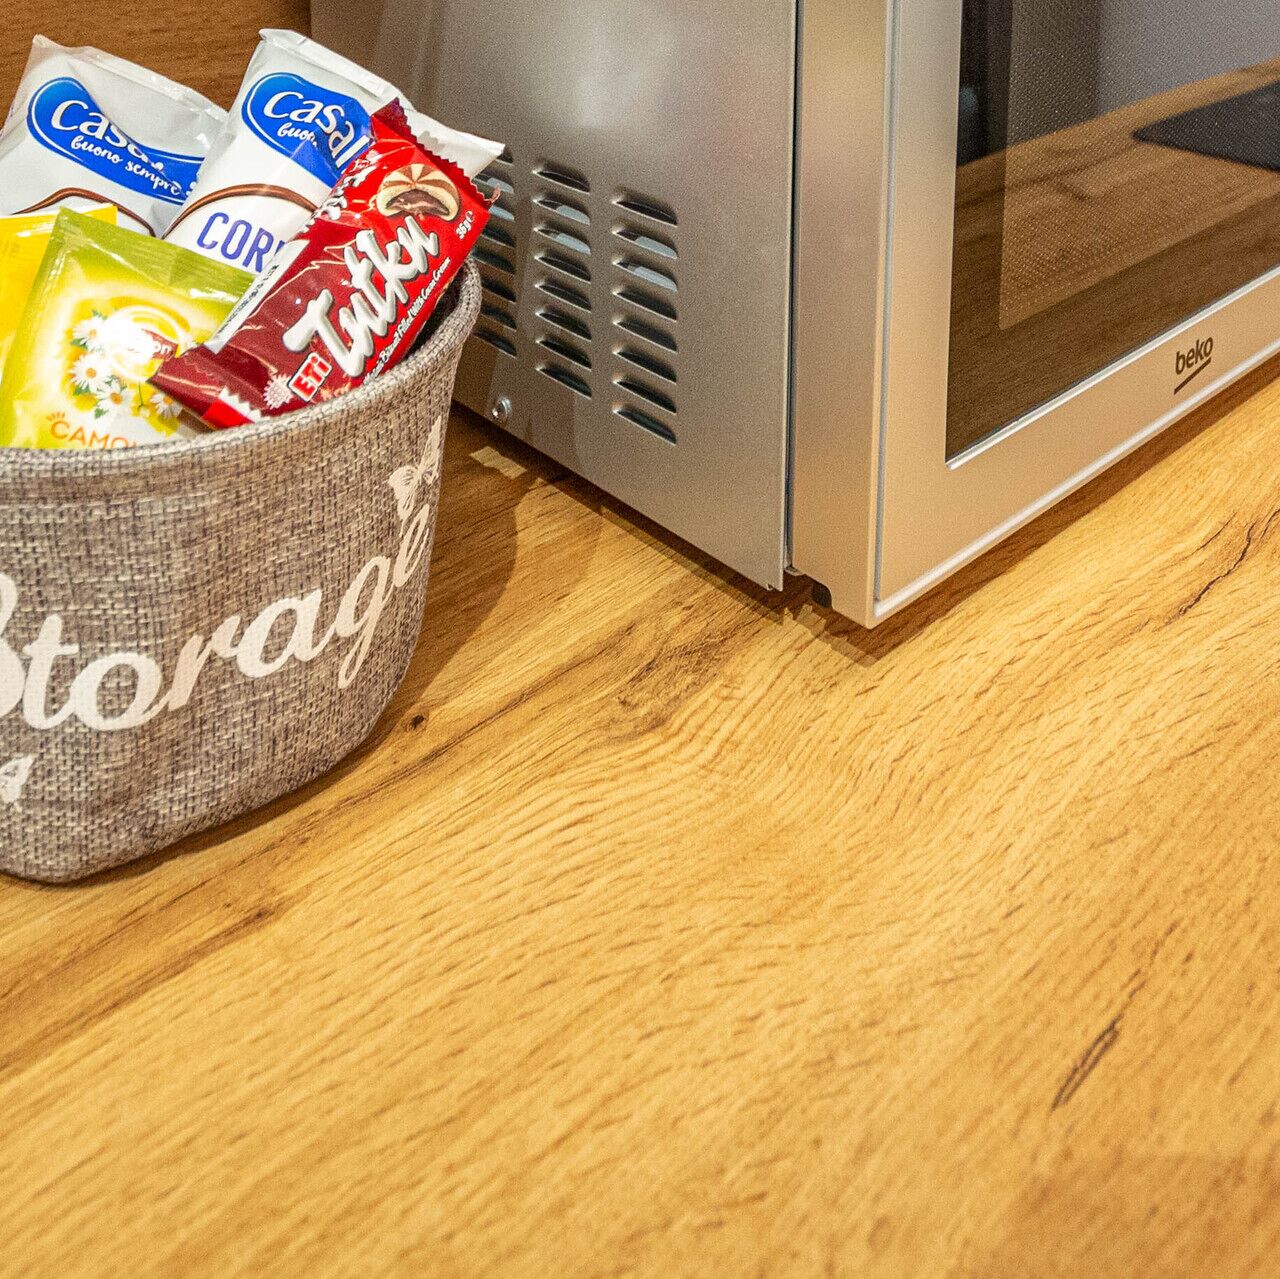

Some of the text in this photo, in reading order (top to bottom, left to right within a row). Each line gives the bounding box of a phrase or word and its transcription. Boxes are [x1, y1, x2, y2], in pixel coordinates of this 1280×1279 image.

[71, 135, 122, 164] buono
[263, 91, 370, 172] Casal
[196, 212, 285, 273] COR
[282, 215, 439, 378] Tutku
[1175, 336, 1214, 375] beko
[50, 419, 137, 448] CAMO
